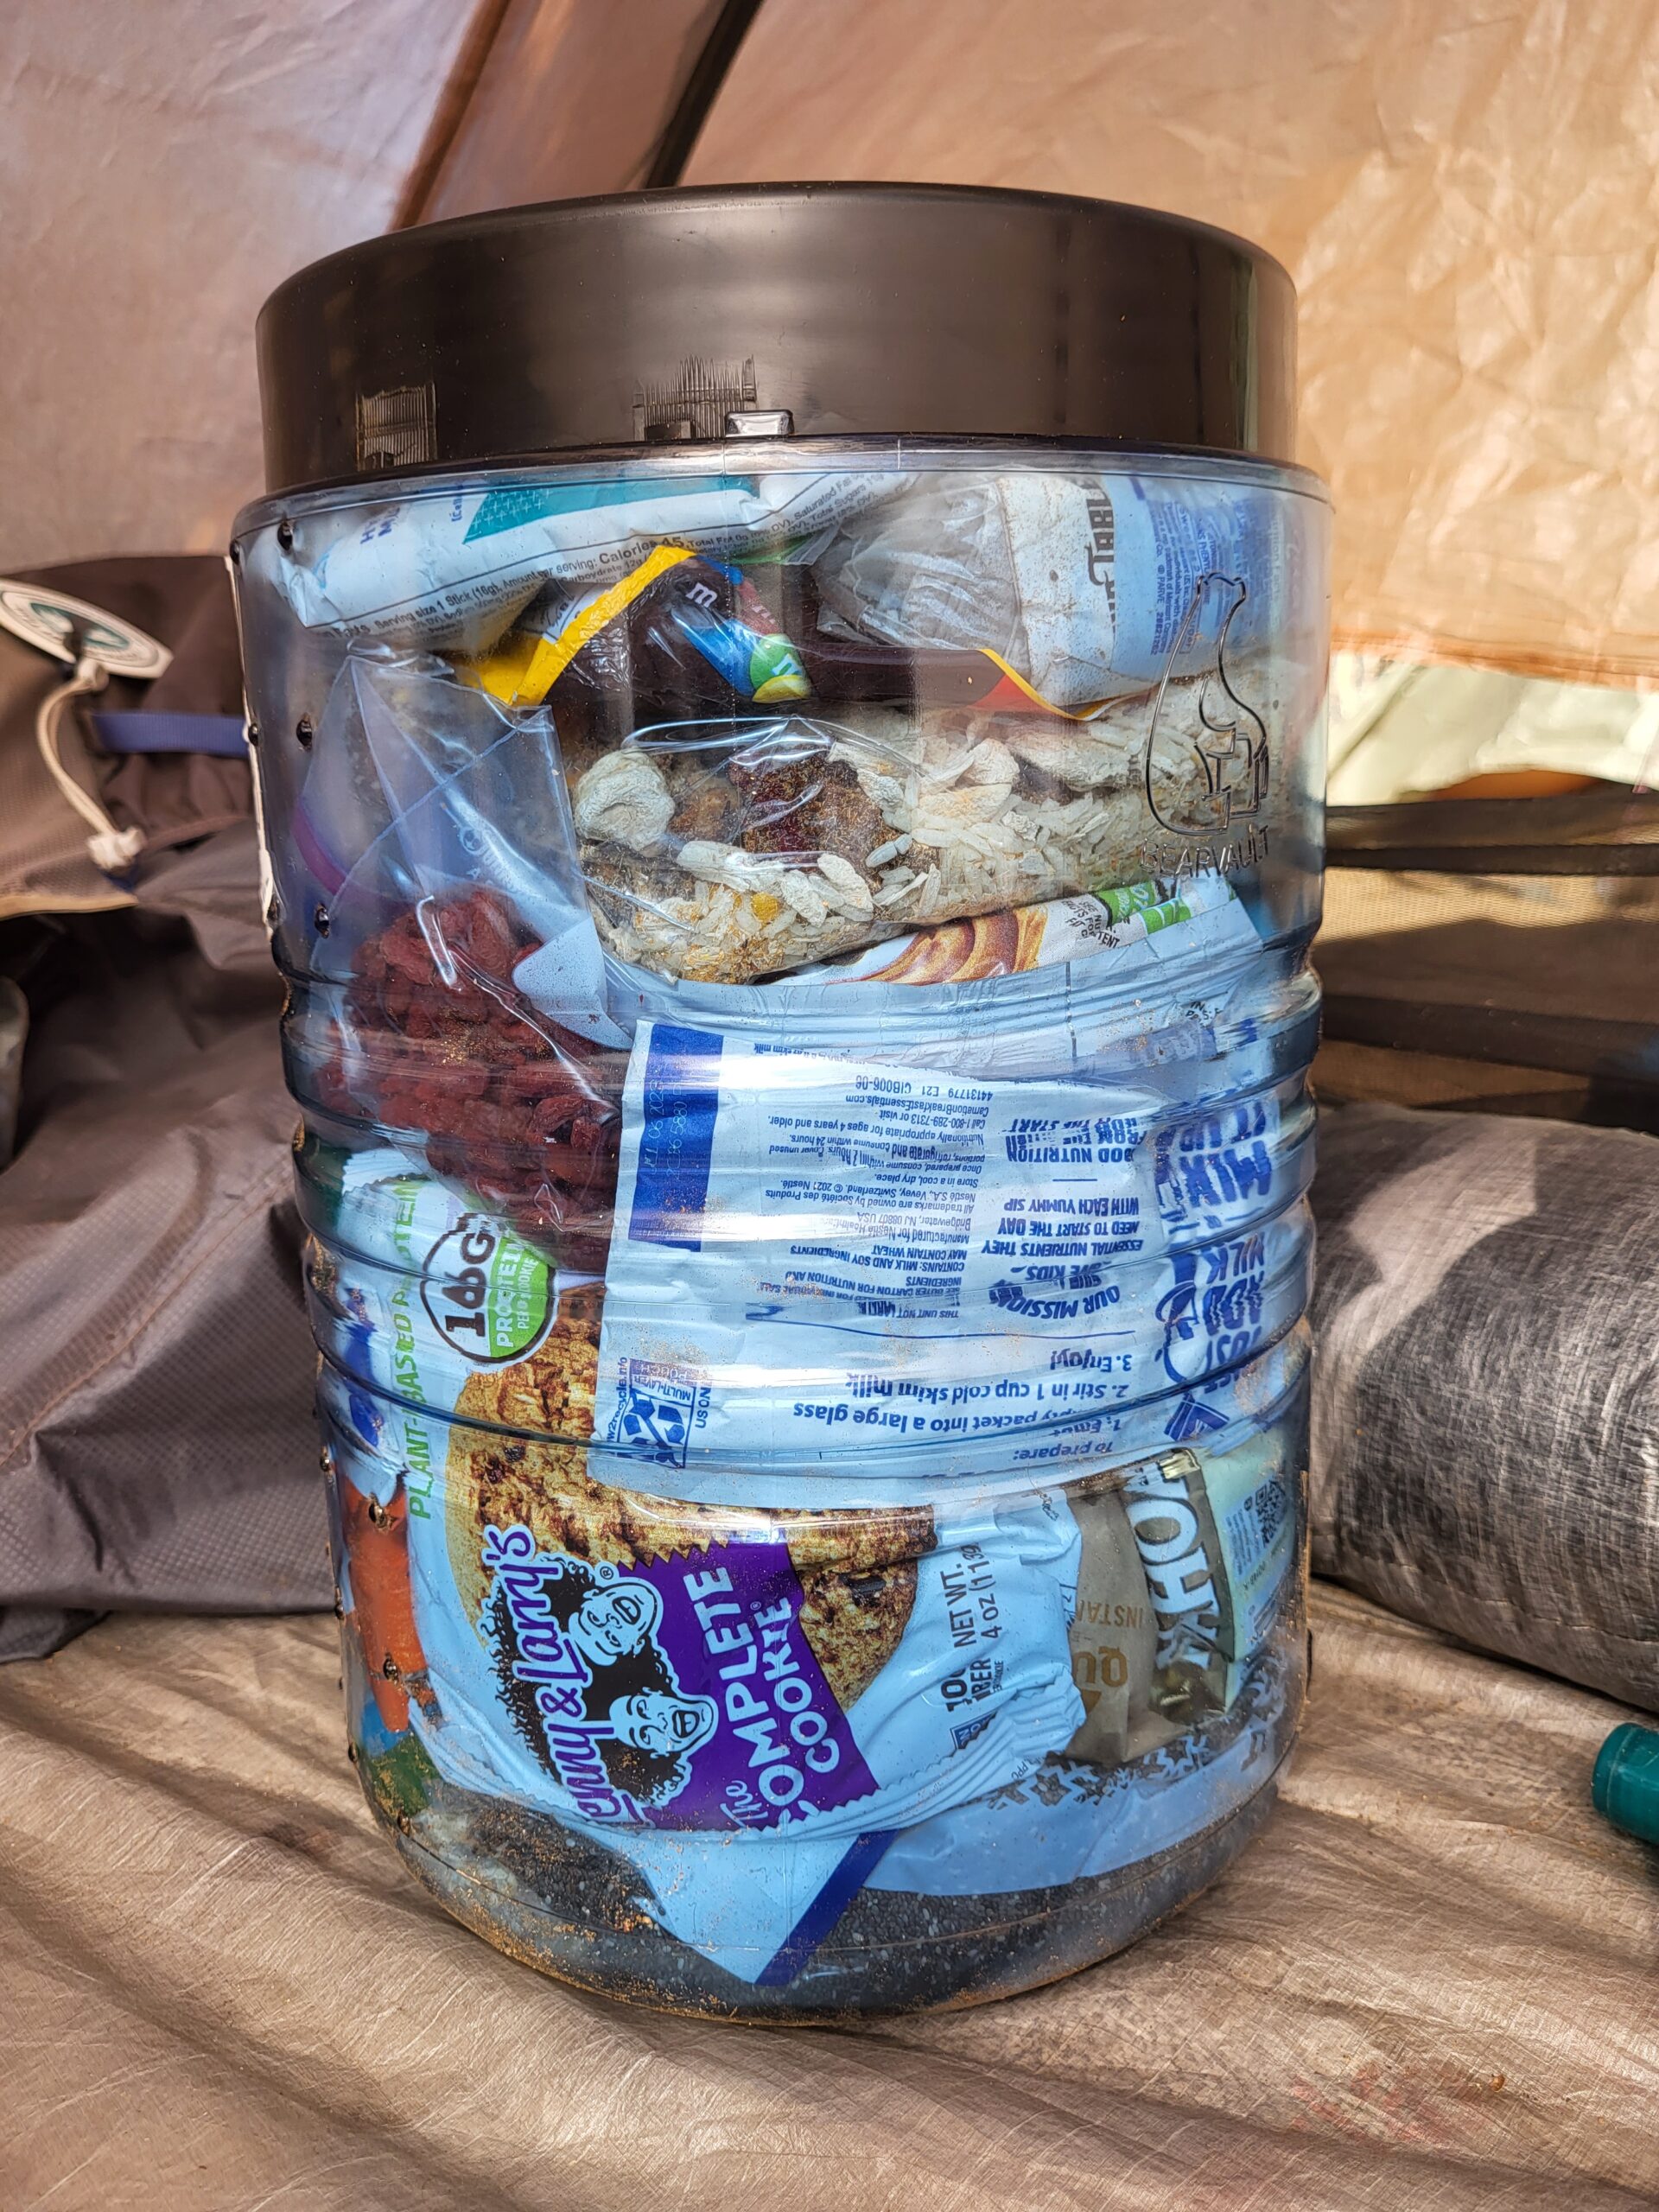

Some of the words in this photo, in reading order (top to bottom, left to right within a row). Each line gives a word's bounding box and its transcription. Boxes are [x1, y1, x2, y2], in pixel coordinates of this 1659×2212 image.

[445, 593, 472, 606] Stick
[503, 570, 538, 589] Amount
[556, 558, 597, 574] serving:
[598, 540, 658, 565] Calories
[1139, 823, 1268, 878] BEARVAULT
[753, 1043, 772, 1054] milk
[921, 1085, 939, 1097] E21
[948, 1088, 994, 1102] 44131779
[845, 1094, 989, 1117] CarnationBreakfastEssentials.com
[767, 1116, 793, 1127] older.
[879, 1109, 898, 1121] visit
[900, 1113, 909, 1122] or
[911, 1113, 970, 1128] 1-800-289-7313
[795, 1118, 812, 1128] and
[814, 1119, 839, 1130] years
[840, 1121, 846, 1131] 4
[847, 1122, 869, 1133] ages
[972, 1118, 986, 1129] Call
[872, 1125, 883, 1137] for
[885, 1125, 936, 1141] appropriate
[789, 1134, 815, 1144] hours.
[816, 1135, 826, 1146] 24
[827, 1136, 852, 1147] within
[853, 1138, 890, 1153] consume
[938, 1132, 984, 1147] Nutritionally
[768, 1145, 799, 1154] unused
[892, 1143, 907, 1160] and
[909, 1146, 951, 1162] refrigerate
[1005, 1141, 1092, 1163] NUTRITION
[860, 1152, 884, 1169] within
[953, 1153, 985, 1163] portions,
[886, 1161, 922, 1171] consume
[924, 1161, 961, 1173] prepared,
[962, 1164, 982, 1174] Once
[779, 1179, 810, 1190] Nestlé.
[874, 1173, 900, 1183] place.
[901, 1173, 916, 1185] dry
[918, 1174, 938, 1185] cool,
[947, 1178, 956, 1187] in
[957, 1178, 979, 1188] Store
[812, 1181, 832, 1192] 2021
[845, 1184, 897, 1198] Switzerland.
[899, 1186, 927, 1198] Vevey,
[765, 1189, 801, 1200] Produits
[803, 1192, 819, 1202] des
[821, 1193, 854, 1205] Société
[854, 1195, 865, 1207] by
[928, 1190, 948, 1200] S.A.,
[950, 1192, 976, 1202] Nestlé
[868, 1198, 896, 1208] owned
[914, 1200, 963, 1212] trademarks
[963, 1205, 975, 1214] All
[1003, 1198, 1026, 1211] SIP
[1027, 1198, 1076, 1215] YUMMY
[1078, 1198, 1109, 1217] EACH
[1111, 1197, 1139, 1216] WITH
[856, 1211, 876, 1222] USA
[880, 1214, 902, 1225] 08807
[905, 1216, 917, 1225] NJ
[918, 1216, 971, 1230] Bridgewater,
[868, 1225, 896, 1239] Nestlé
[897, 1227, 910, 1239] for
[997, 1217, 1027, 1236] DAY
[1029, 1221, 1052, 1236] THE
[1056, 1222, 1090, 1236] START
[1093, 1222, 1109, 1235] TO
[1111, 1221, 1140, 1235] NEED
[912, 1230, 969, 1244] Manufactured
[790, 1245, 850, 1262] INGREDIENTS
[871, 1245, 905, 1257] WHEAT
[906, 1248, 947, 1259] CONTAIN
[982, 1239, 1016, 1255] THEY
[1020, 1243, 1087, 1257] NUTRIENTS
[1090, 1239, 1143, 1255] ESSENTIAL
[851, 1254, 870, 1266] SOY
[949, 1250, 967, 1260] MAY
[1200, 1231, 1265, 1284] MILK
[873, 1256, 893, 1269] AND
[895, 1260, 918, 1271] MILK
[919, 1262, 965, 1272] CONTAINS:
[785, 1271, 806, 1281] AND
[807, 1273, 855, 1292] NUTRITION
[906, 1275, 962, 1287] INGREDIENTS
[442, 1232, 496, 1337] 16G
[857, 1284, 875, 1294] FOR
[876, 1286, 912, 1296] CARTON
[836, 1292, 854, 1300] FOR
[915, 1287, 944, 1296] OUTER
[1082, 1285, 1121, 1314] OUR
[896, 1309, 916, 1318] NOT
[918, 1309, 938, 1318] UNIT
[1050, 1348, 1112, 1372] Enjoy!
[1116, 1354, 1133, 1371] 3.
[633, 1375, 691, 1402] MULTI-LAYER
[845, 1374, 893, 1398] milk
[995, 1379, 1030, 1398] cup
[1037, 1383, 1045, 1400] 1
[1052, 1383, 1069, 1401] in
[1072, 1382, 1108, 1399] Stir
[1111, 1384, 1128, 1398] 2.
[898, 1382, 949, 1404] skim
[951, 1386, 990, 1405] cold
[695, 1409, 709, 1429] US
[792, 1403, 849, 1426] glass
[853, 1407, 908, 1433] large
[973, 1410, 1038, 1429] packet
[913, 1417, 925, 1430] a
[930, 1417, 968, 1433] into
[1106, 1416, 1122, 1431] 1.
[1013, 1440, 1092, 1460] prepare:
[1095, 1441, 1113, 1453] To
[940, 1563, 967, 1606] WT.
[486, 1531, 589, 1682] Larry's
[949, 1608, 977, 1648] NET
[981, 1625, 1002, 1639] 4
[753, 1597, 841, 1774] COOKIE
[539, 1688, 582, 1719] &
[720, 1779, 768, 1828] The
